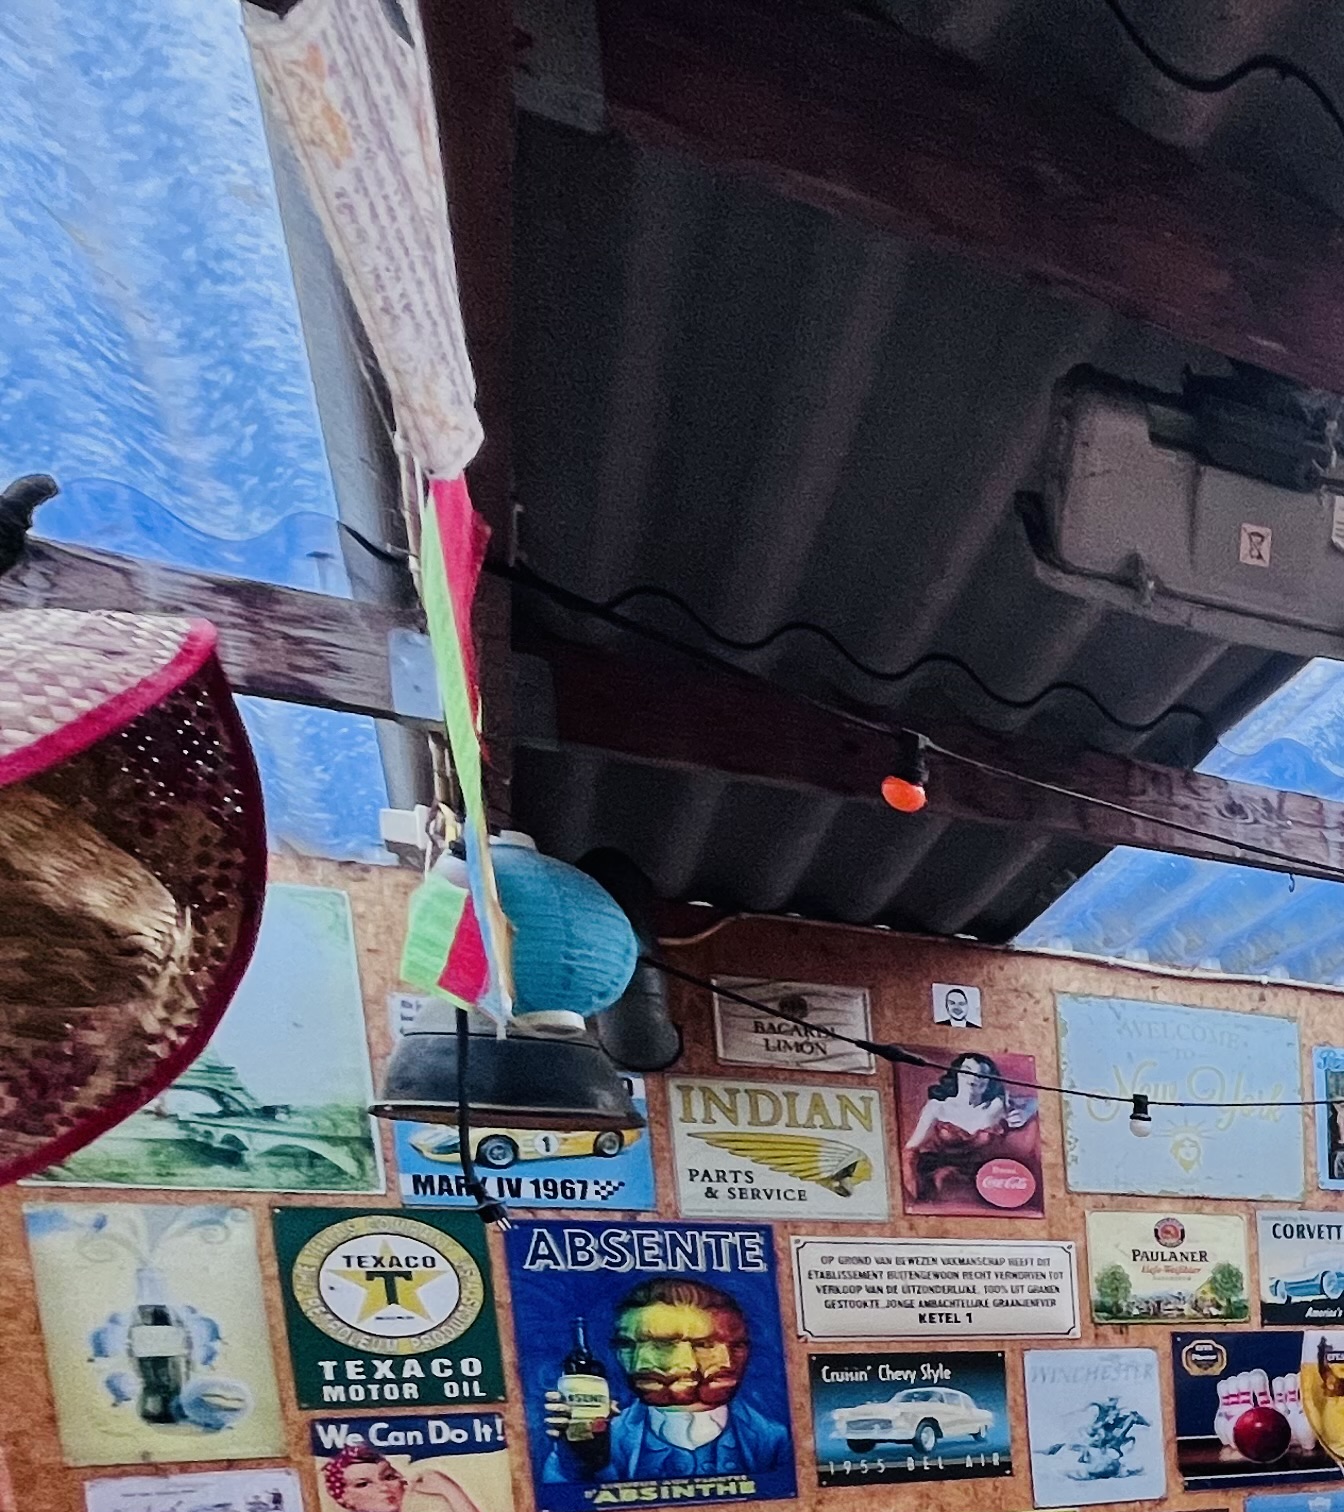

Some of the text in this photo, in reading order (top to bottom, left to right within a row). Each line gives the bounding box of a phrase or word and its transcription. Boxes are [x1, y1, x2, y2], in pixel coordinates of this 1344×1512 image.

[1118, 1019, 1242, 1050] WELCOME
[1086, 1060, 1285, 1131] New York
[676, 1085, 874, 1132] INDIAN
[542, 1136, 551, 1153] 1
[687, 1168, 754, 1184] PARTS
[497, 1177, 522, 1198] IV
[531, 1178, 589, 1200] 1967
[704, 1187, 808, 1201] & SERVICE
[343, 1255, 437, 1268] TEXACO
[524, 1228, 766, 1273] ABSENTE
[874, 1256, 892, 1265] VAN
[1131, 1249, 1209, 1262] PAULANER
[365, 1271, 413, 1305] T
[865, 1285, 884, 1294] VAN
[918, 1312, 973, 1323] KETEL 1
[318, 1357, 483, 1381] TEXACO
[878, 1363, 917, 1384] Chevy
[919, 1363, 952, 1382] Style
[1030, 1361, 1154, 1384] WINCHESTER
[322, 1380, 487, 1402] MOTOR OIL
[317, 1418, 505, 1449] We Can Do It!
[828, 1453, 1001, 1477] 1955 BEL AIR
